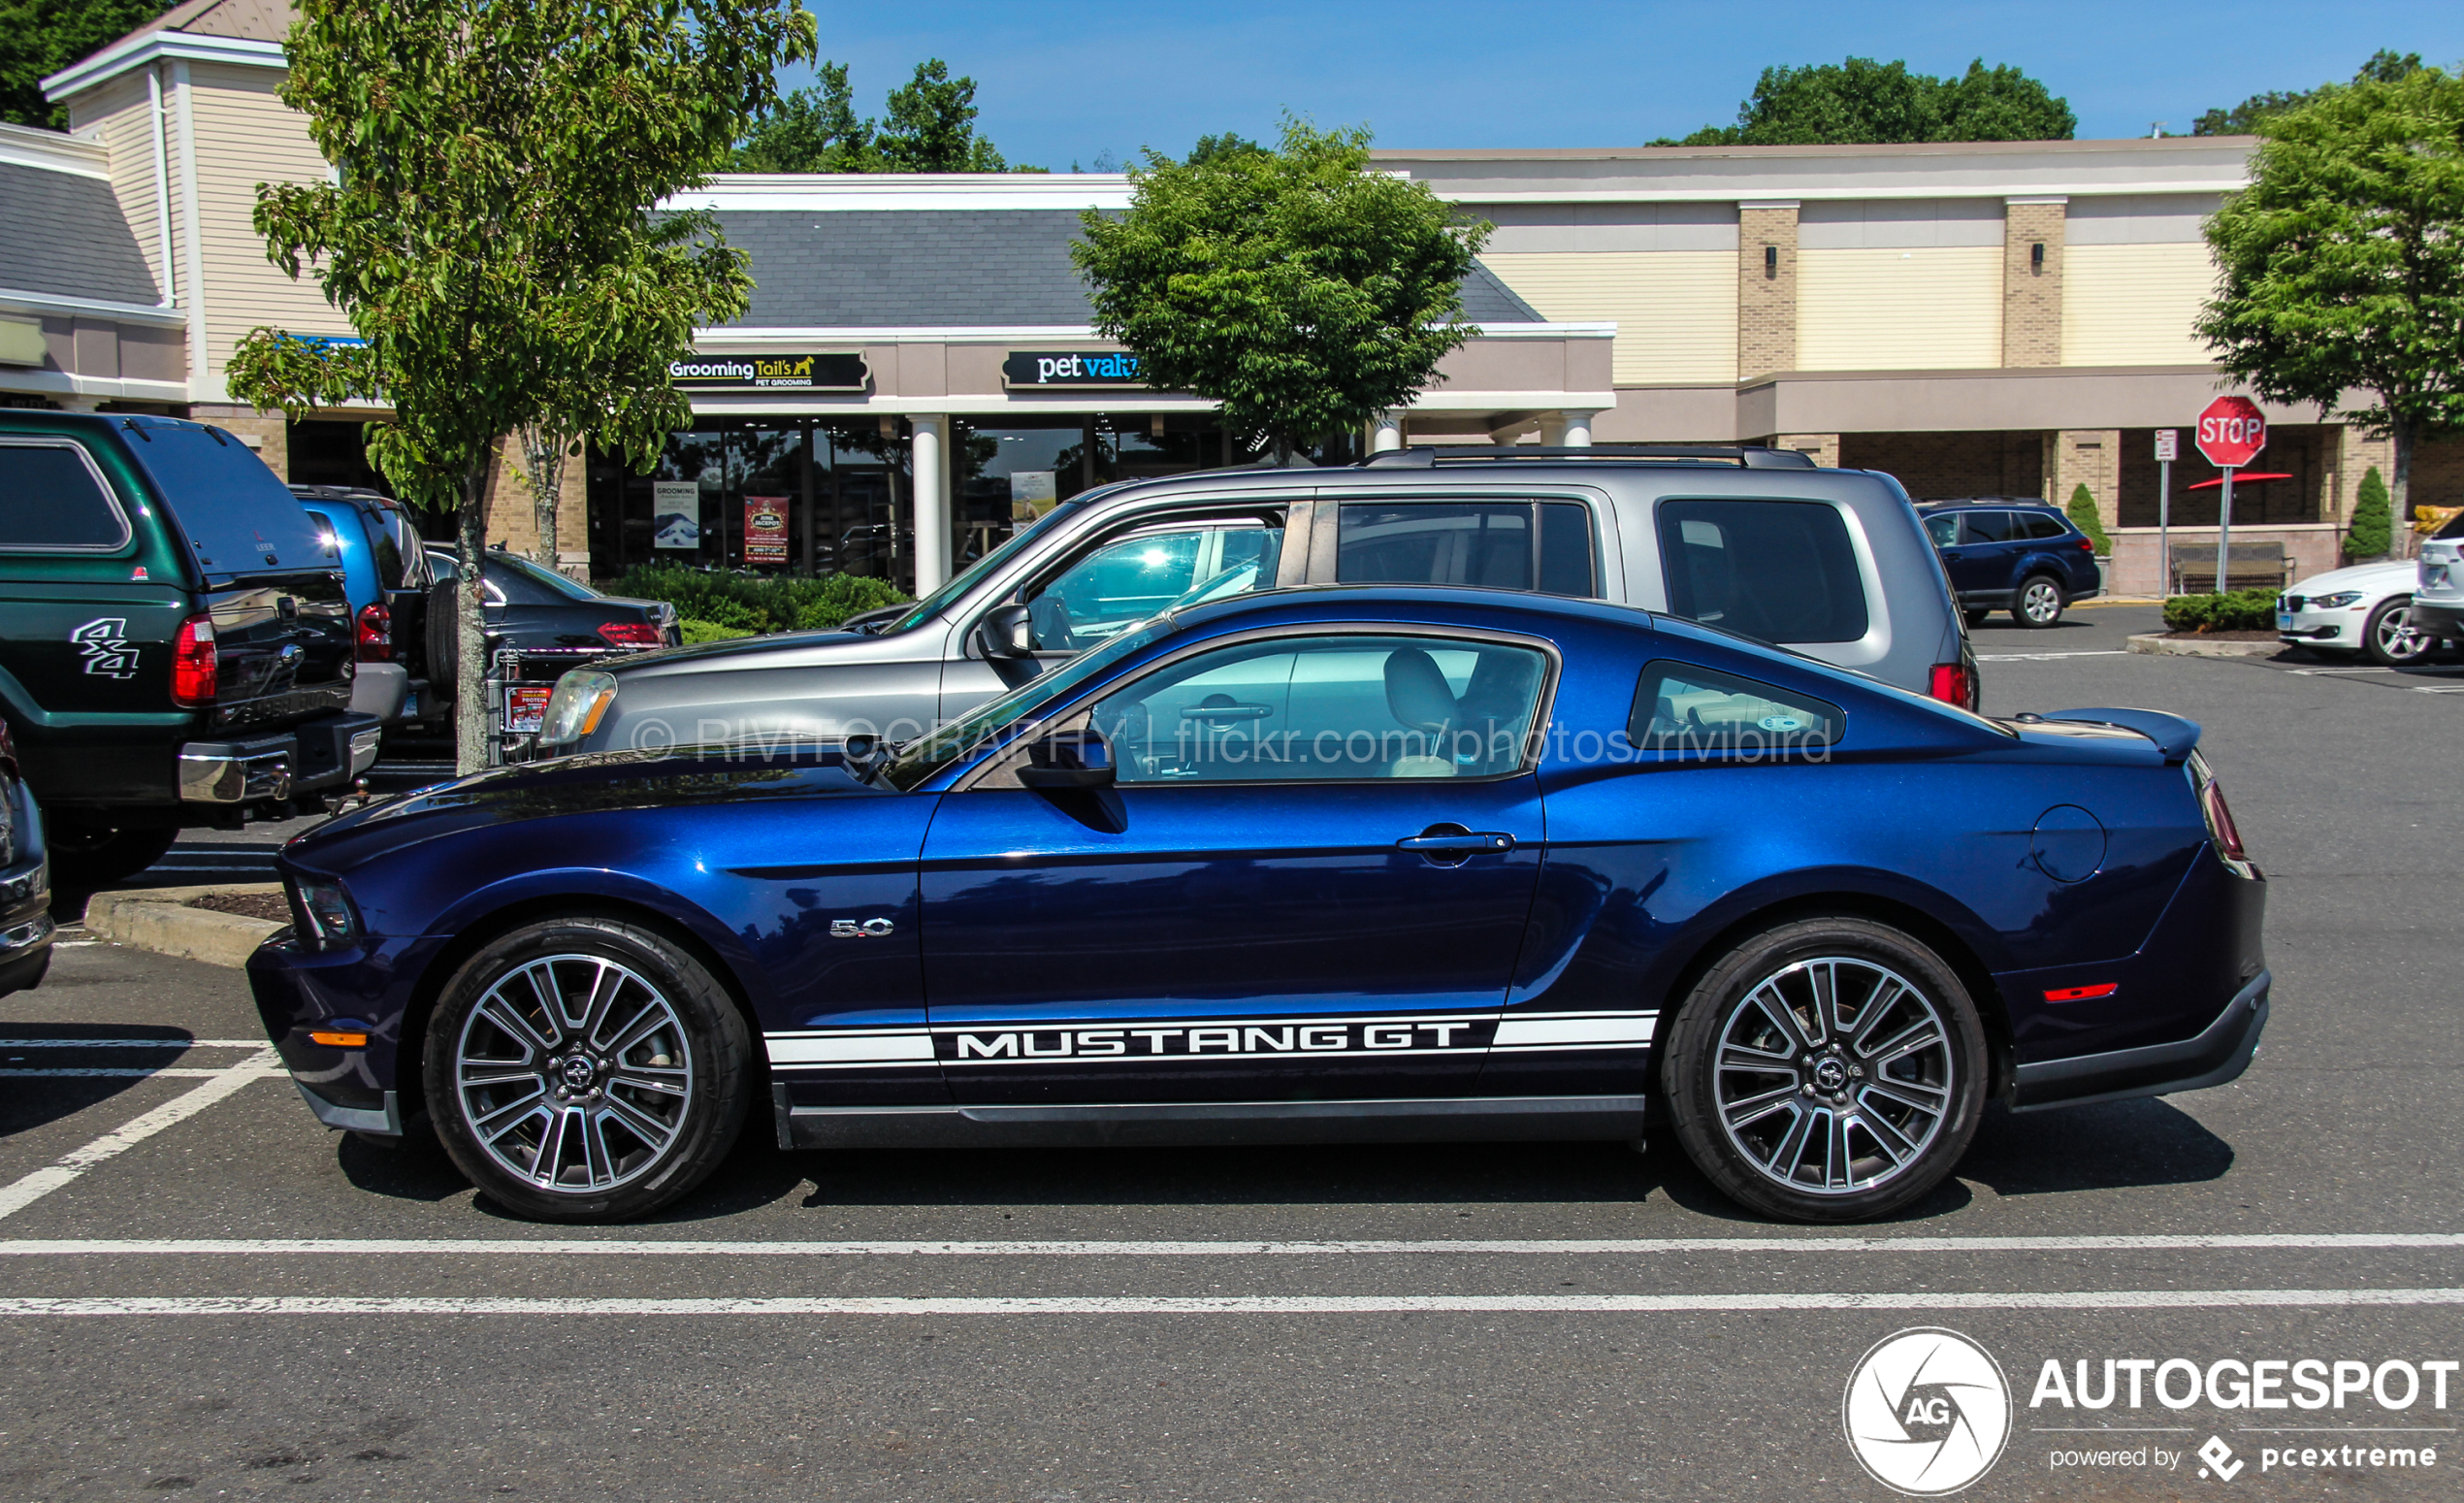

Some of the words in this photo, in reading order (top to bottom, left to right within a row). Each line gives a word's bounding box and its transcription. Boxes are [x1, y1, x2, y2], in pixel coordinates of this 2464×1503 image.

[669, 361, 754, 379] Grooming
[755, 360, 792, 376] Tail's
[1037, 354, 1082, 383] pet
[2200, 417, 2261, 443] STOP
[255, 542, 276, 552] LEER
[829, 917, 894, 938] 5.0
[957, 1025, 1348, 1060] MUSTANG
[1363, 1023, 1471, 1048] GT
